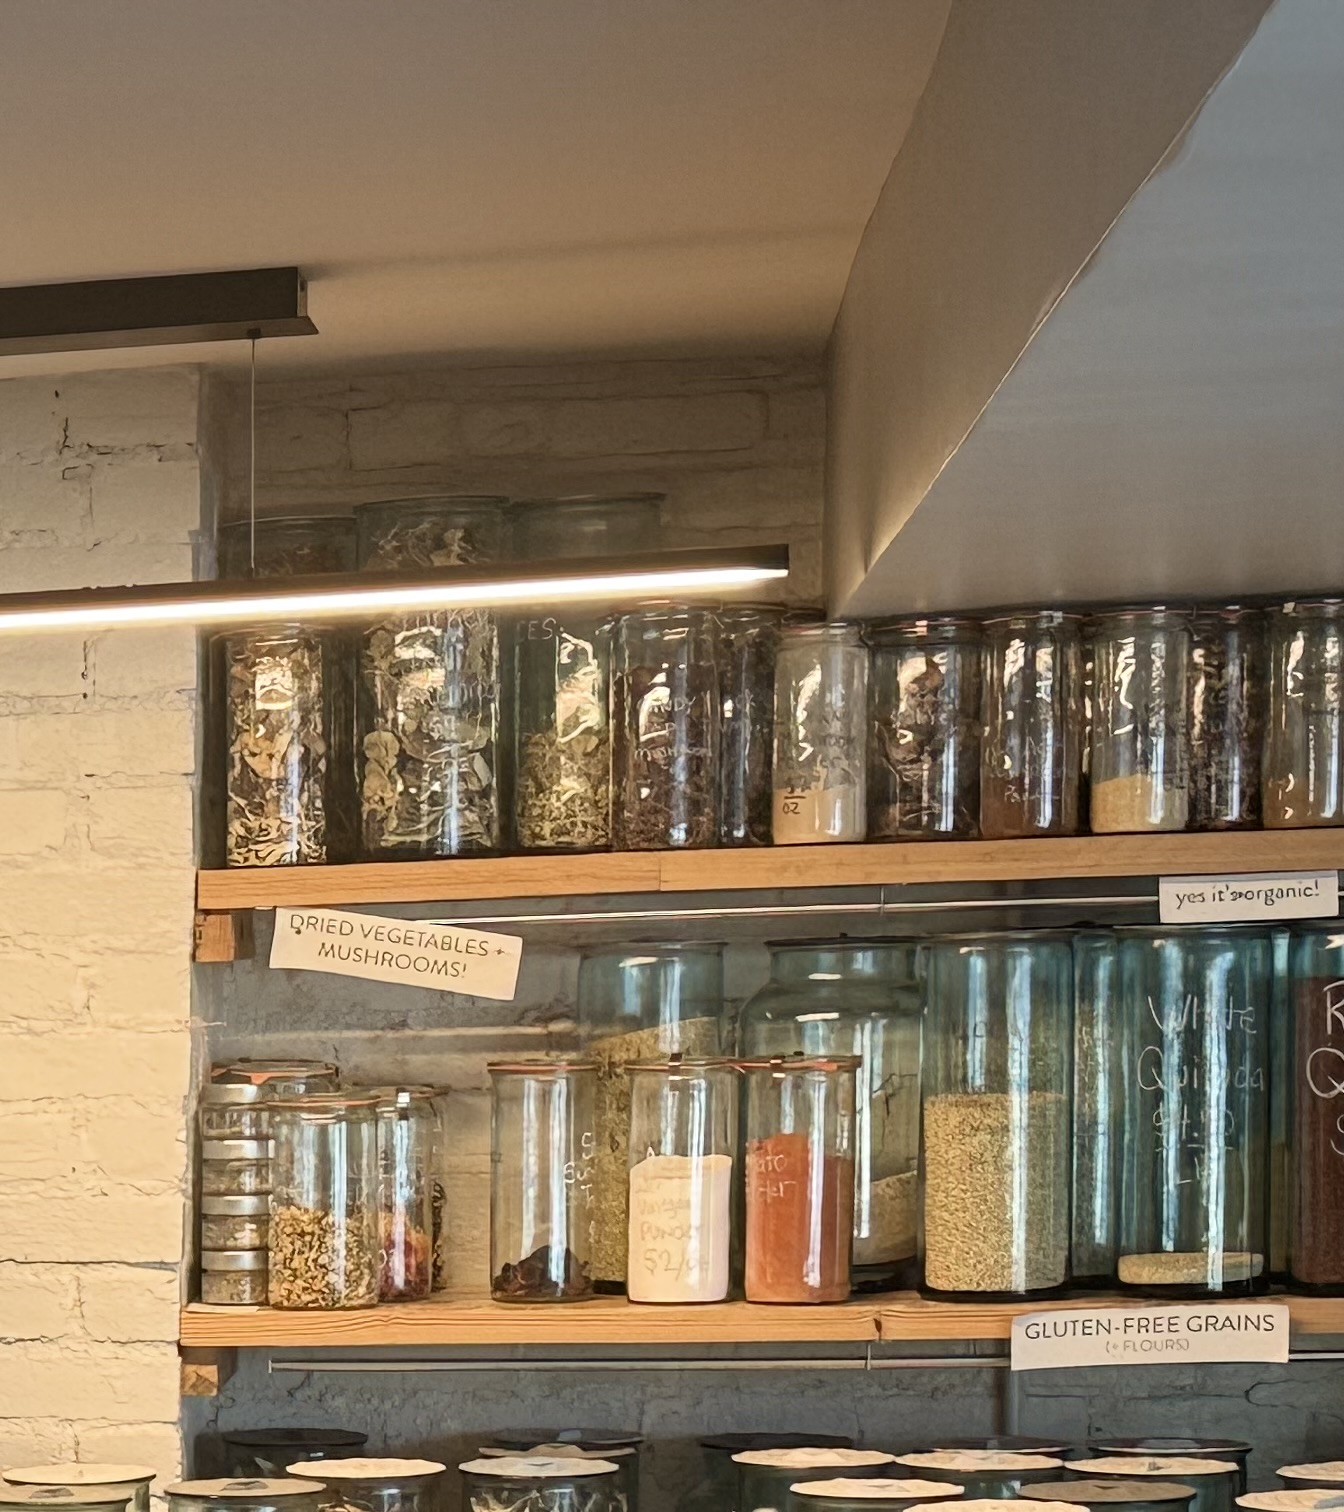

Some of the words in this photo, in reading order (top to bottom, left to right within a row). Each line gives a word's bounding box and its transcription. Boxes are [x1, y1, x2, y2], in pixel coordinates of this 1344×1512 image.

[1174, 886, 1207, 912] yes
[1243, 879, 1321, 909] organic!
[289, 912, 355, 938] DRIED
[359, 923, 490, 958] VEGETABLES
[317, 942, 468, 979] MUSHROOMS!
[1024, 1316, 1181, 1341] GLUTEN-FREE
[1186, 1313, 1276, 1335] GRAINS
